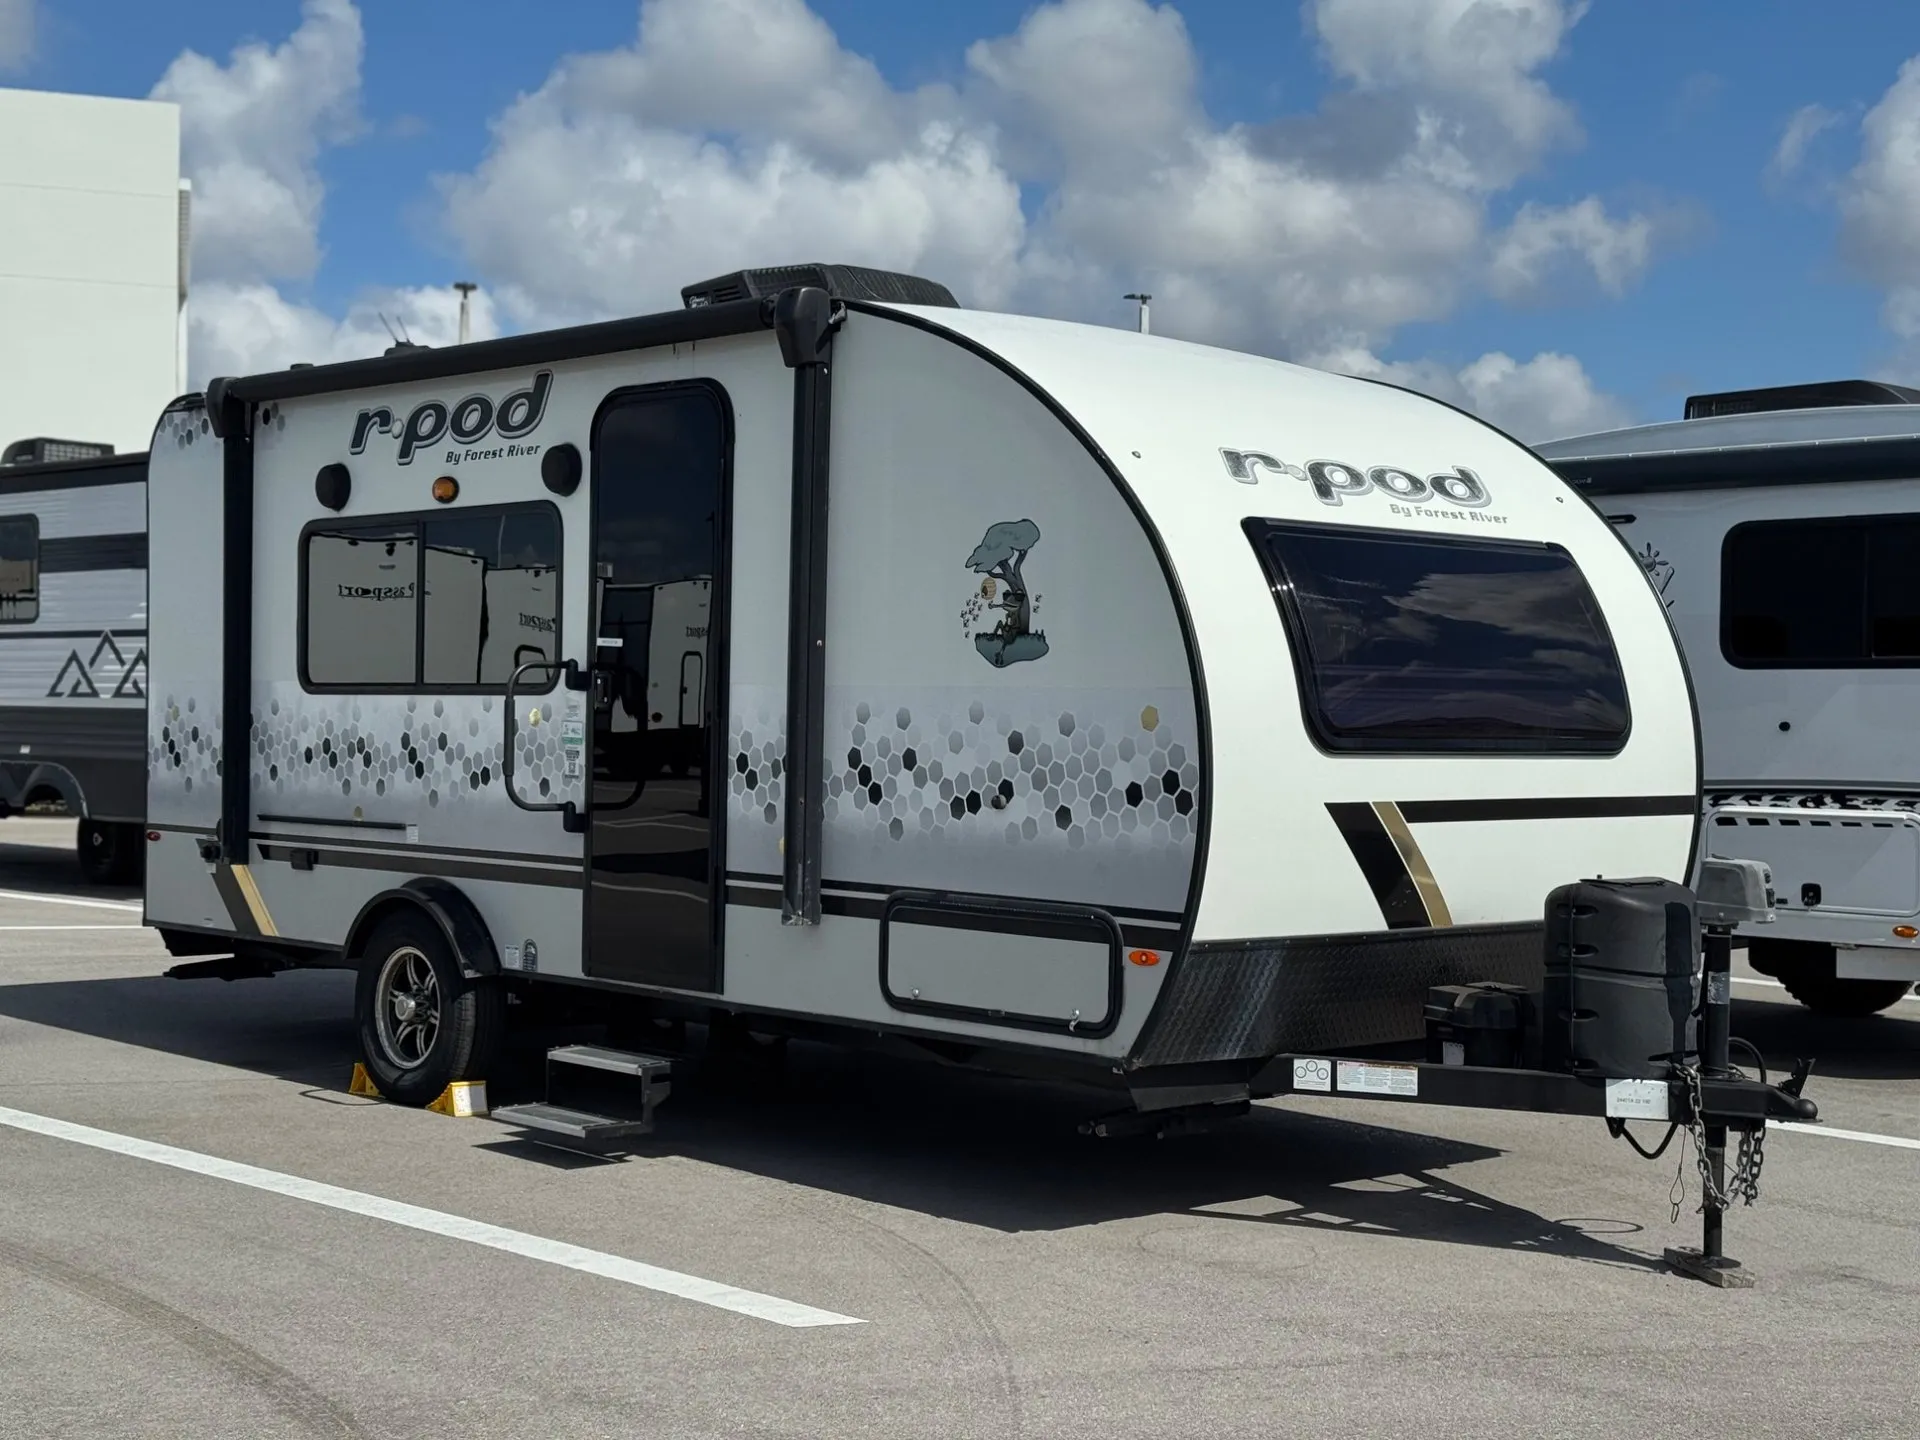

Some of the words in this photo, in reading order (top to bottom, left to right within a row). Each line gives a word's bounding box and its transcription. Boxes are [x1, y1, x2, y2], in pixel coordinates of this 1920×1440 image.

[445, 451, 461, 466] By
[464, 447, 504, 462] Forest
[507, 444, 541, 457] River
[1389, 504, 1412, 518] By
[1414, 506, 1467, 520] Forest
[1468, 511, 1508, 524] River
